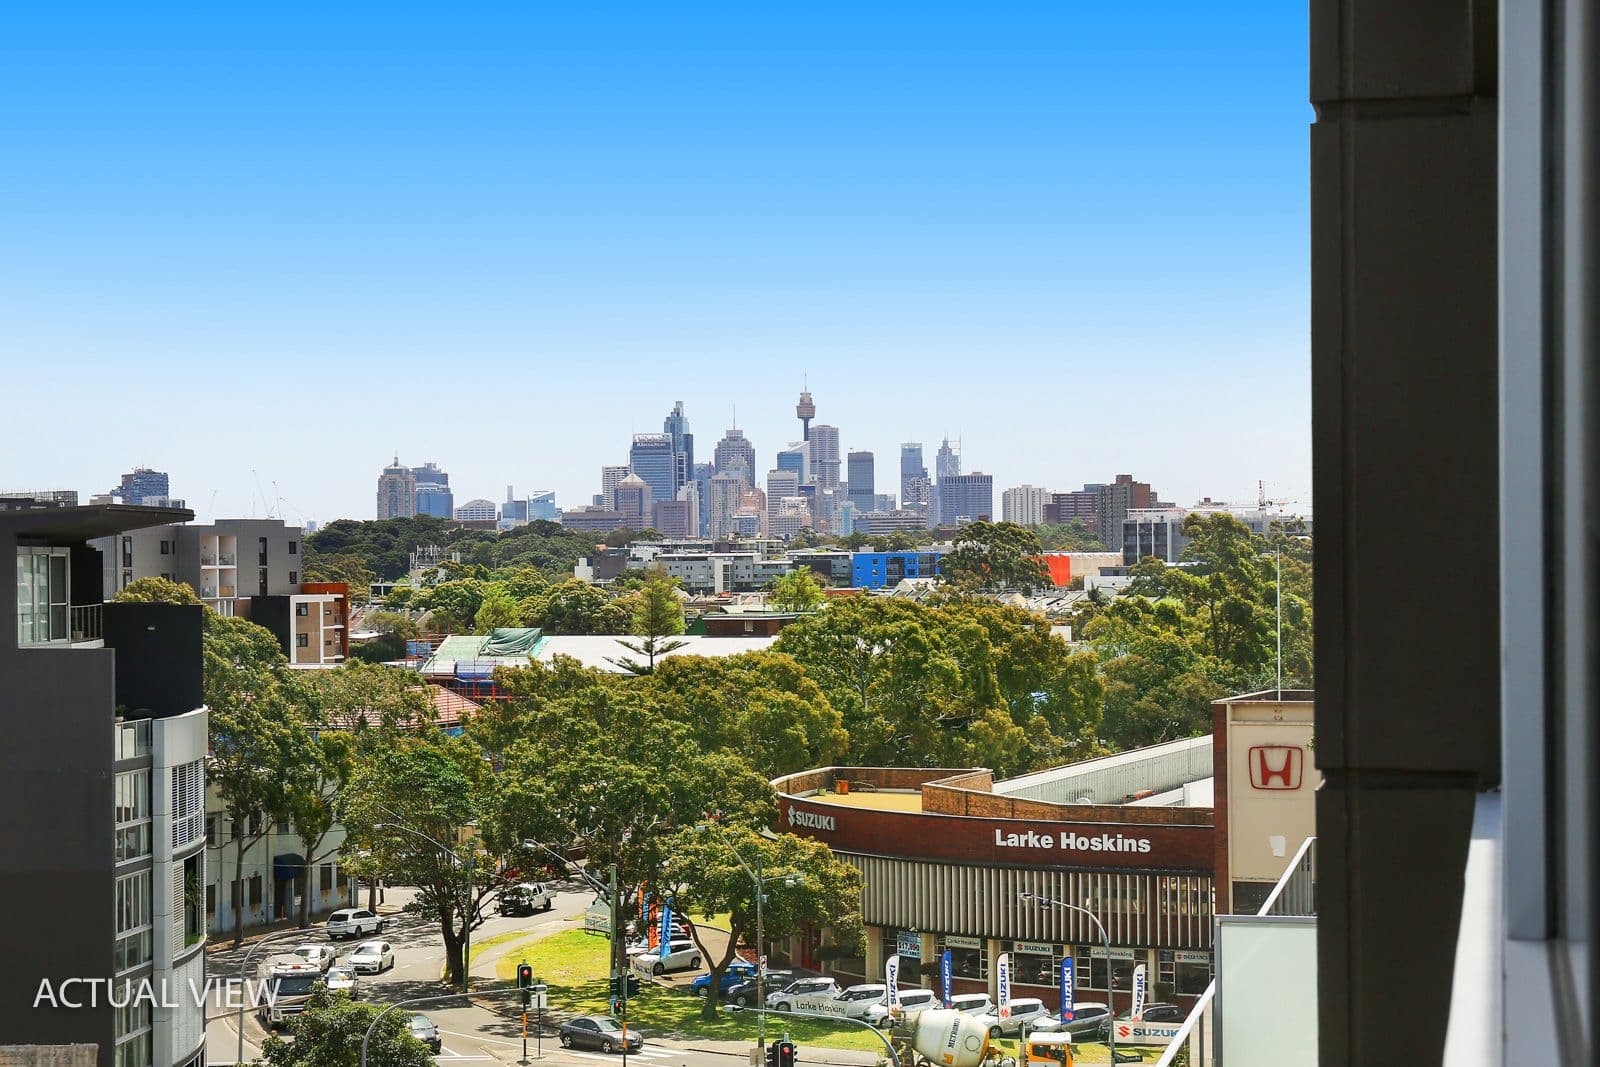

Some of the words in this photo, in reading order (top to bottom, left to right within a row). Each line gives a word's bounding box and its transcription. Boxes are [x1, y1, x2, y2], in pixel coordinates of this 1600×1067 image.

[795, 811, 836, 831] SUZUKI
[995, 829, 1054, 849] Larke
[1060, 831, 1151, 853] Hoskins
[889, 964, 897, 1005] SUZUKI
[1064, 967, 1073, 1009] SUZUKI
[1135, 973, 1144, 1014] SUZUKI
[795, 1001, 817, 1010] Larke
[818, 1003, 846, 1014] Hoskins
[1133, 1028, 1179, 1037] SUZUK
